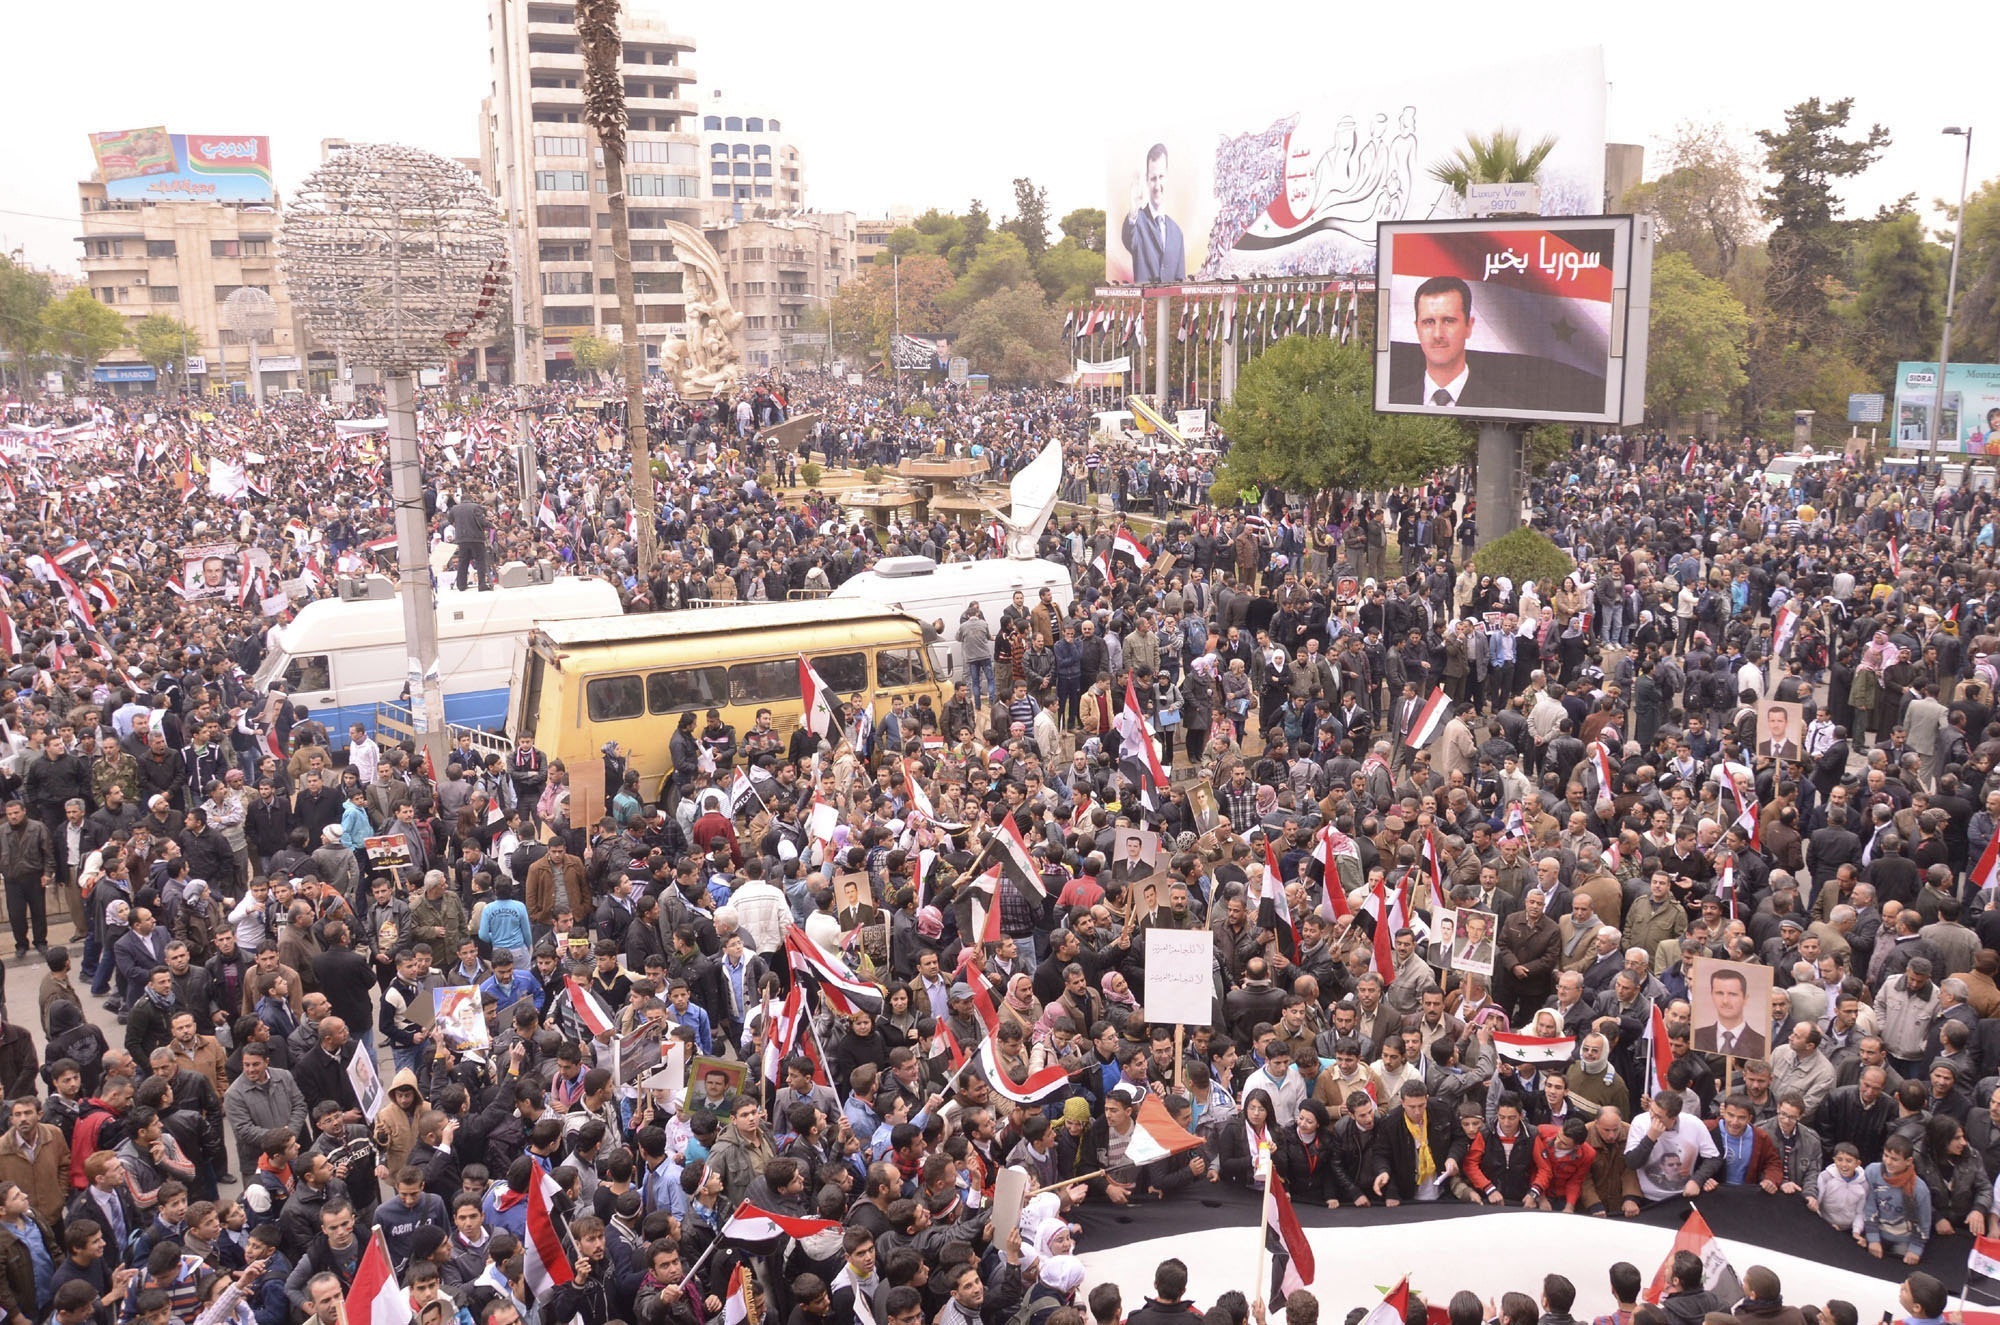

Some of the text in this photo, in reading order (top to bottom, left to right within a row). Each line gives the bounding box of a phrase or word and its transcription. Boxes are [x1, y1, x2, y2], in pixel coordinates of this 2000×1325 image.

[1490, 199, 1517, 210] 9970
[1482, 236, 1600, 281] سوريا بخير
[1909, 374, 1932, 382] SIDRA
